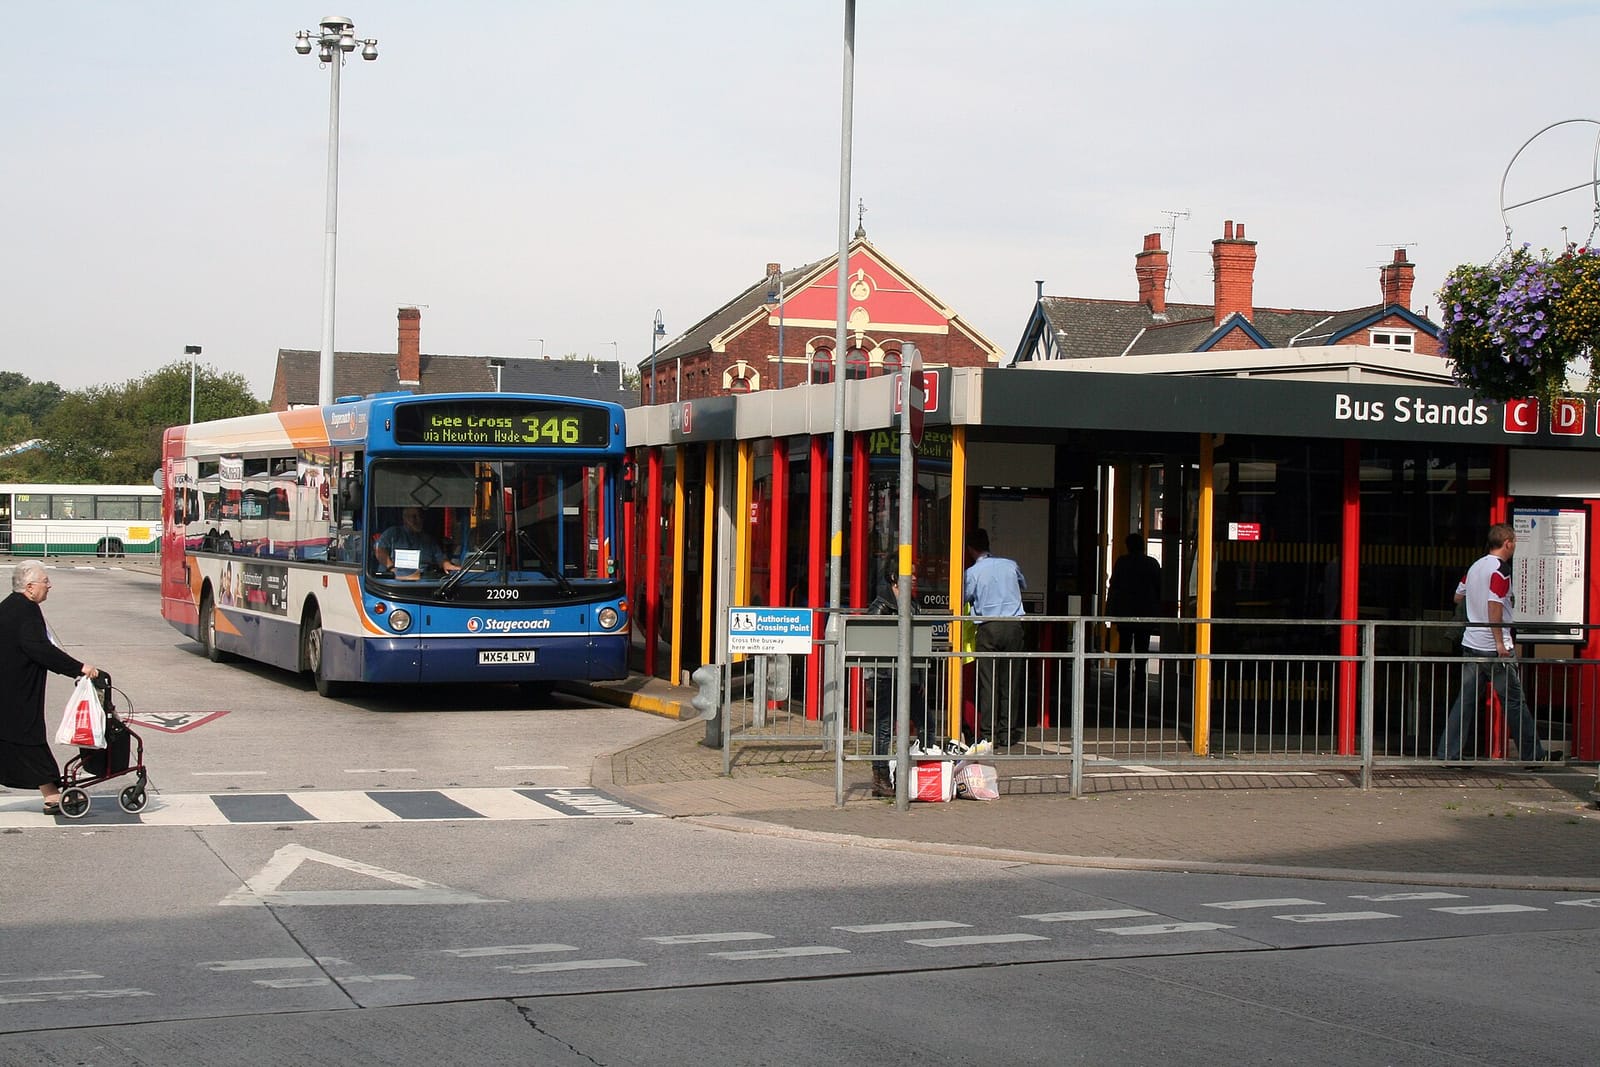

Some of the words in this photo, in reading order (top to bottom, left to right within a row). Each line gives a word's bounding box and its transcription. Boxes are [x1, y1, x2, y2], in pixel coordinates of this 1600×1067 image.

[1335, 394, 1385, 421] Bus
[1394, 396, 1488, 425] Stands
[1513, 403, 1529, 426] C
[1560, 404, 1576, 427] D
[431, 415, 463, 427] Gee
[468, 415, 512, 428] Cross
[423, 428, 440, 442] via
[443, 429, 488, 442] Newton
[494, 429, 520, 443] Hyde
[521, 416, 579, 444] 346
[486, 588, 519, 600] 22090
[485, 617, 550, 632] Stagecoach
[757, 615, 800, 623] Authorised
[756, 624, 788, 632] Crossing
[790, 624, 810, 632] Point
[761, 637, 784, 645] busway
[483, 652, 509, 663] MX54
[511, 652, 531, 663] LRV
